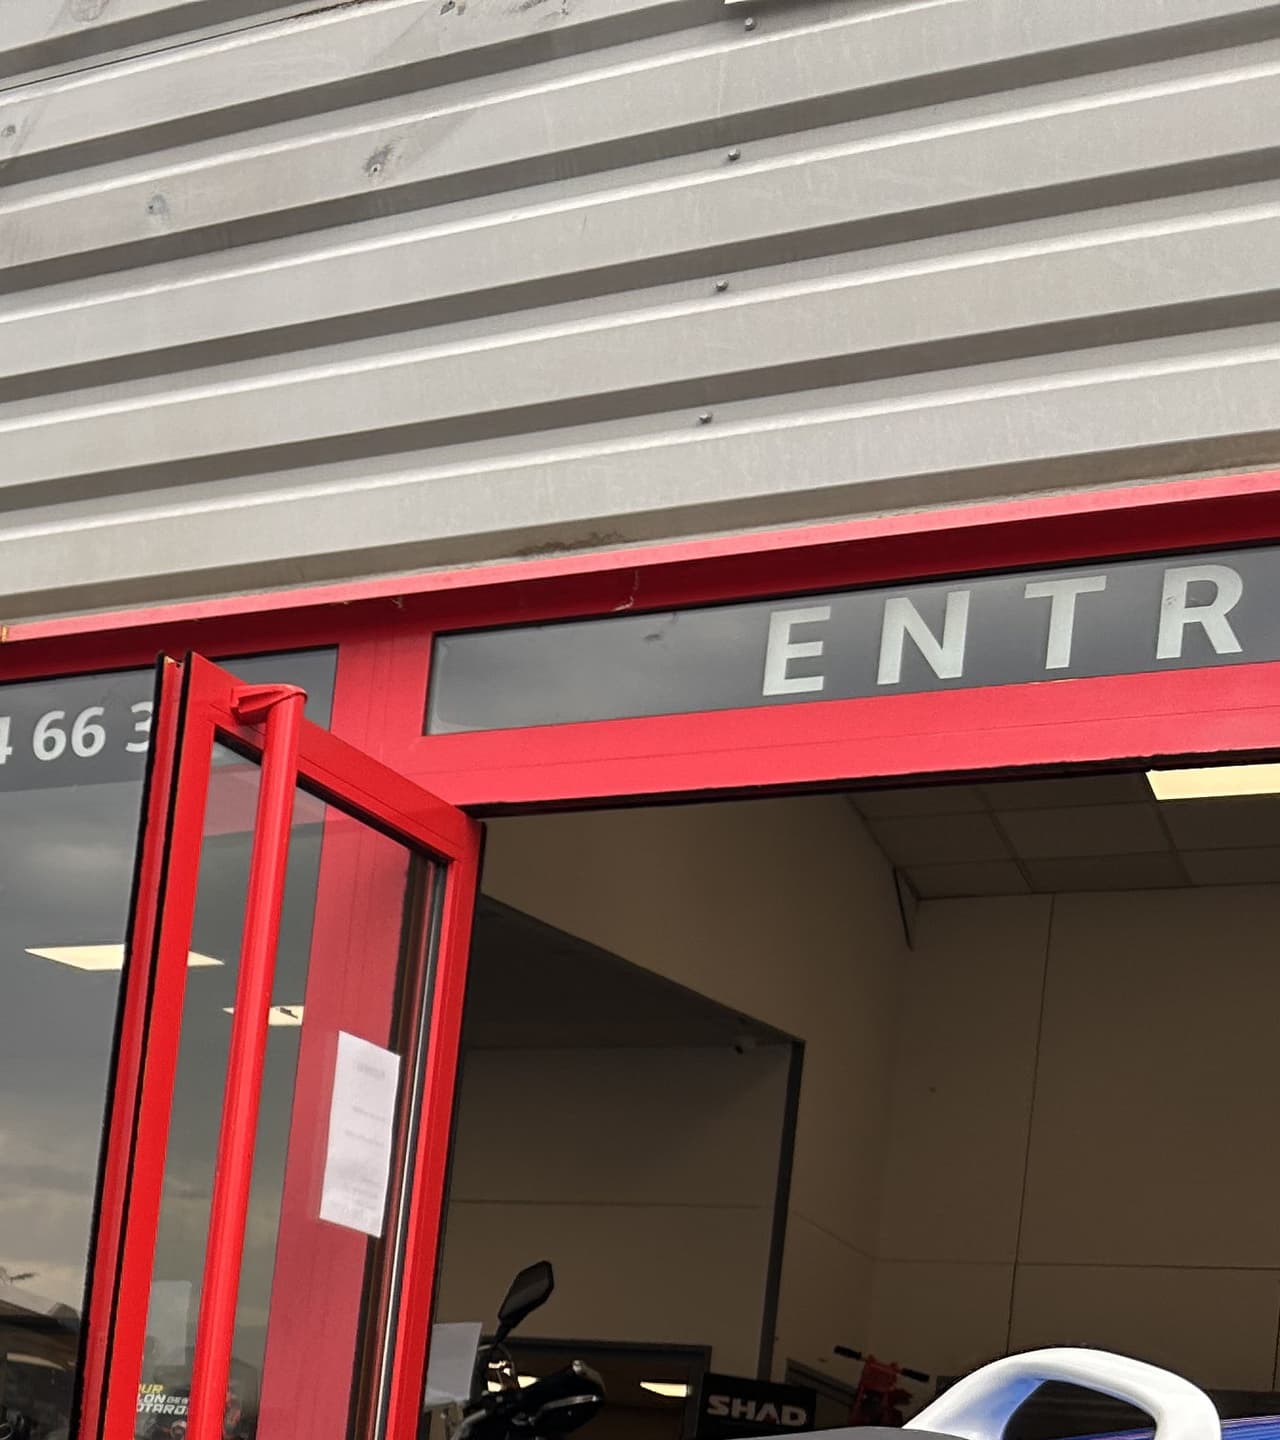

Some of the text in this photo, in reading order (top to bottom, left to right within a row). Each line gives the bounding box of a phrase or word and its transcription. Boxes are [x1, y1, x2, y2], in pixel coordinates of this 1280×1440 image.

[762, 563, 1244, 697] ENTR
[32, 706, 106, 761] 66
[125, 701, 154, 753] 3
[136, 1403, 188, 1416] OTARD
[707, 1394, 807, 1426] SHAD
